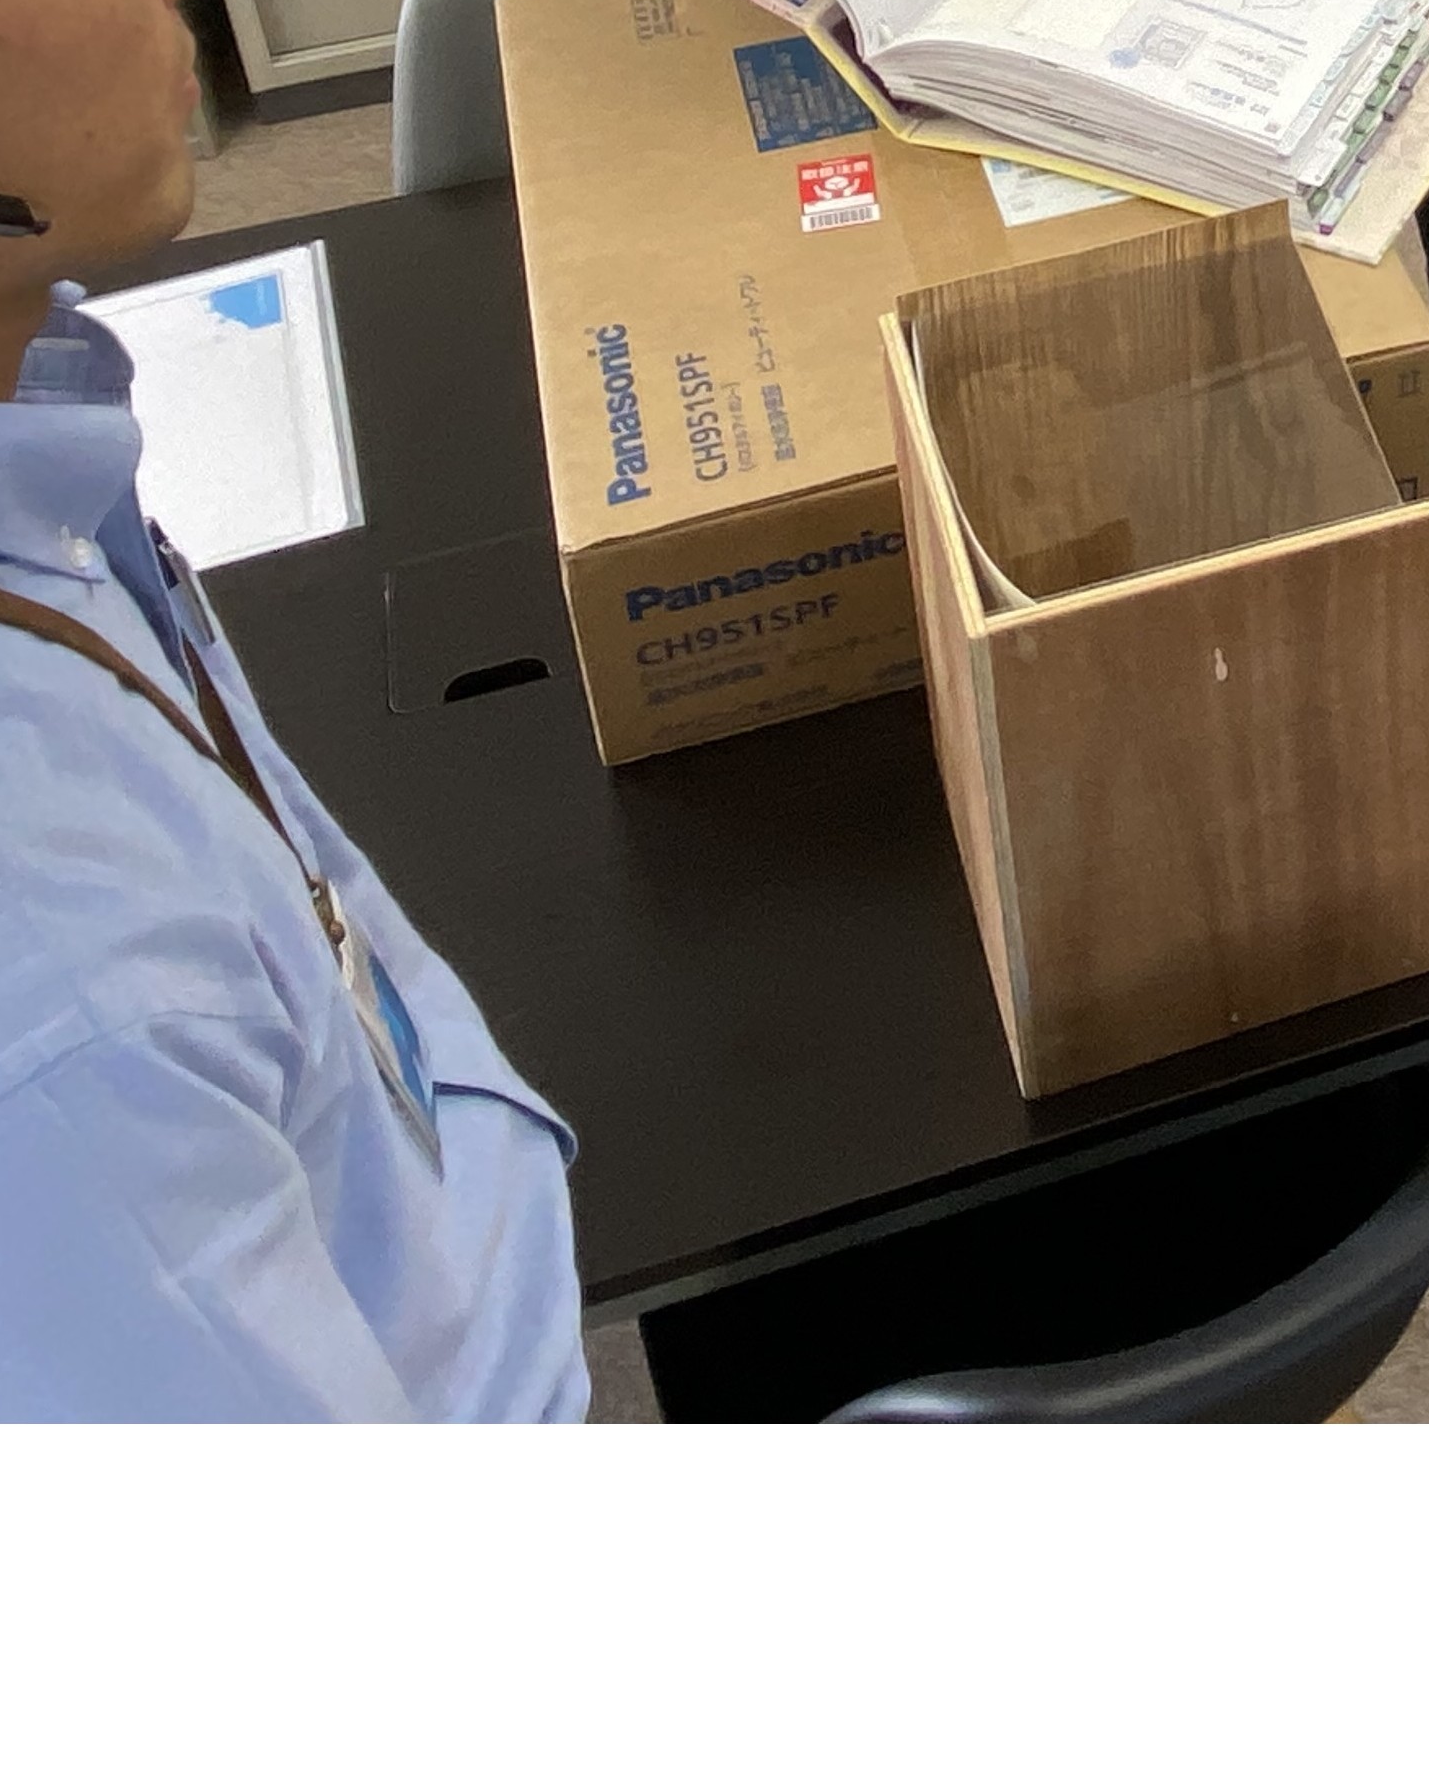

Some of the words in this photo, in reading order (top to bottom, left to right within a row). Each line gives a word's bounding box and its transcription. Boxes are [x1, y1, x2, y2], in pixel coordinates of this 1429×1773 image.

[587, 323, 652, 507] Panasonic
[675, 352, 728, 483] CH951SPF
[625, 529, 906, 622] Panasonic
[636, 594, 841, 666] CH951SPF
